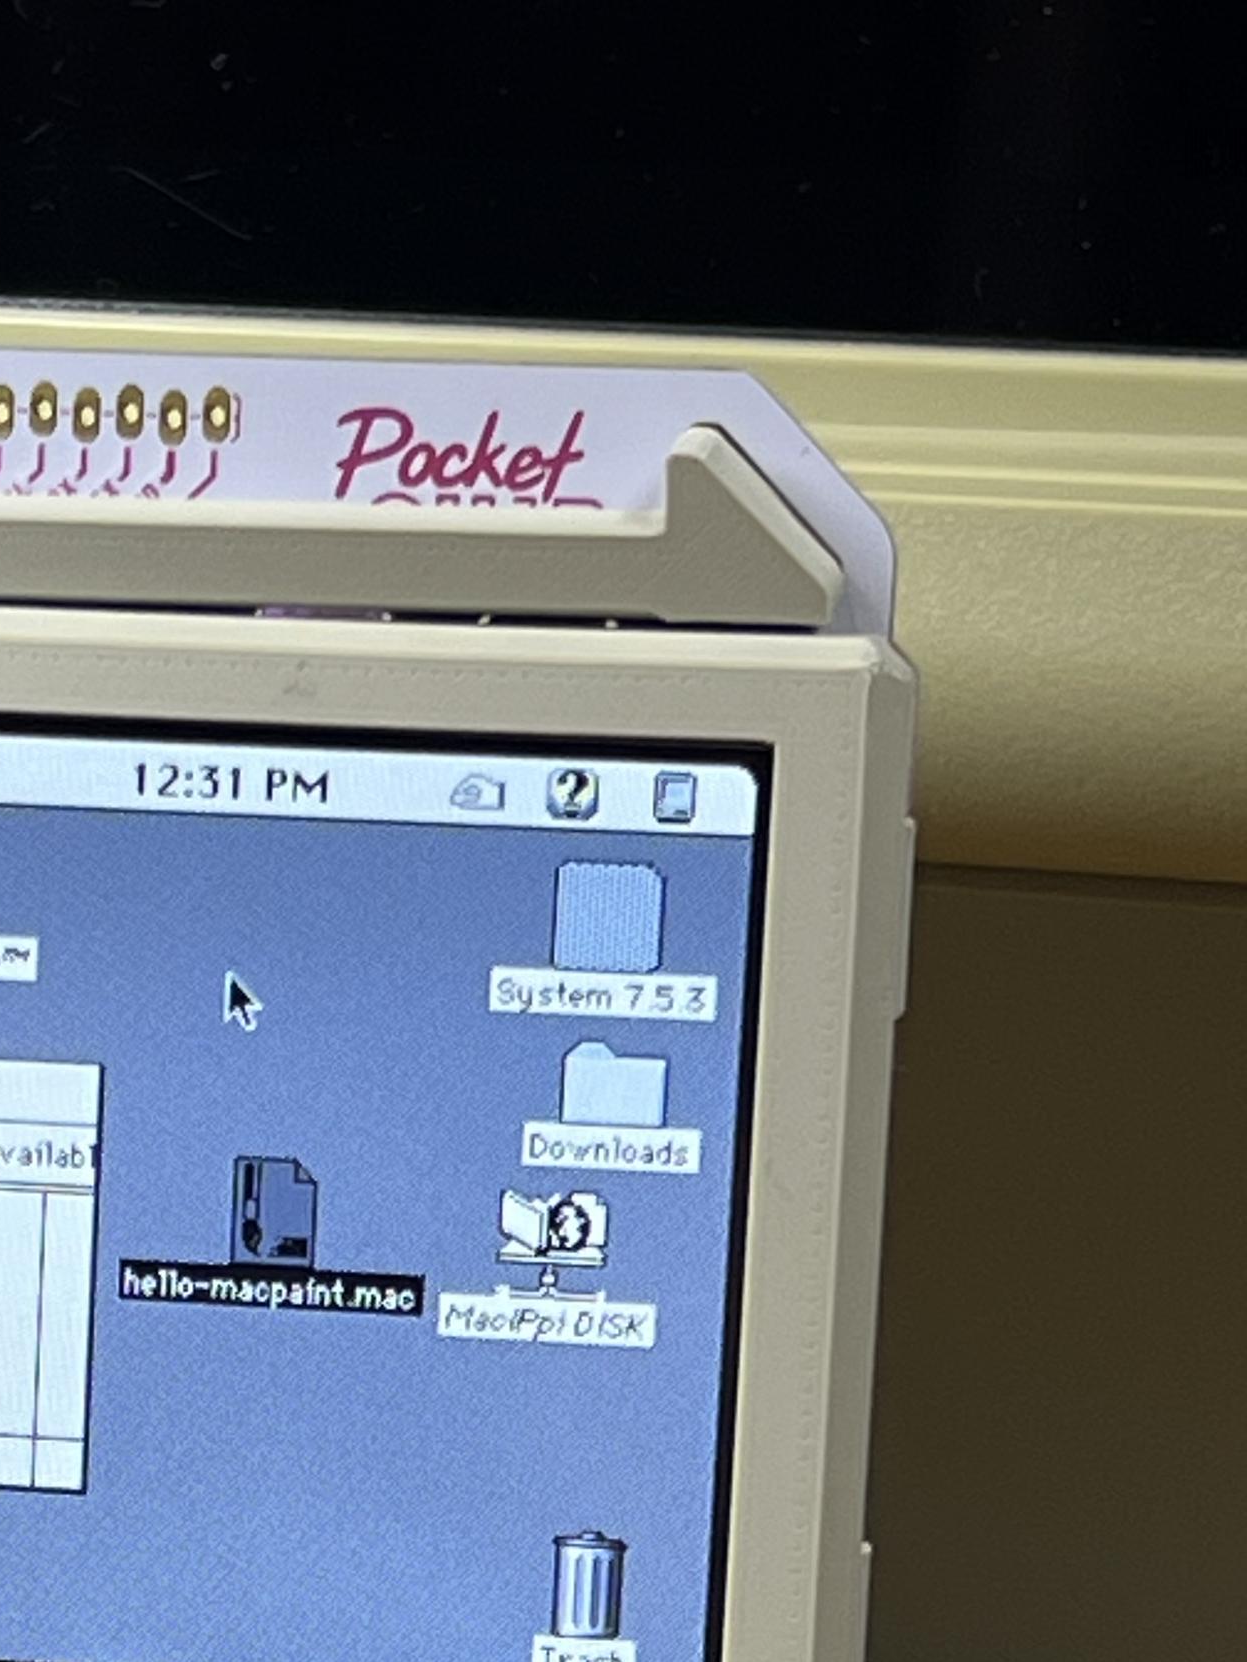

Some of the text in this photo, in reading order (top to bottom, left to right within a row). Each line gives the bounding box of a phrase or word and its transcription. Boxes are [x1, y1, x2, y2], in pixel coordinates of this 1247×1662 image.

[335, 406, 585, 503] Pocket
[133, 762, 330, 804] 12:31 PM
[496, 977, 613, 1014] System
[527, 1131, 690, 1167] Downloads
[122, 1268, 417, 1312] hello-macpaint.mac
[573, 1310, 650, 1341] DISK
